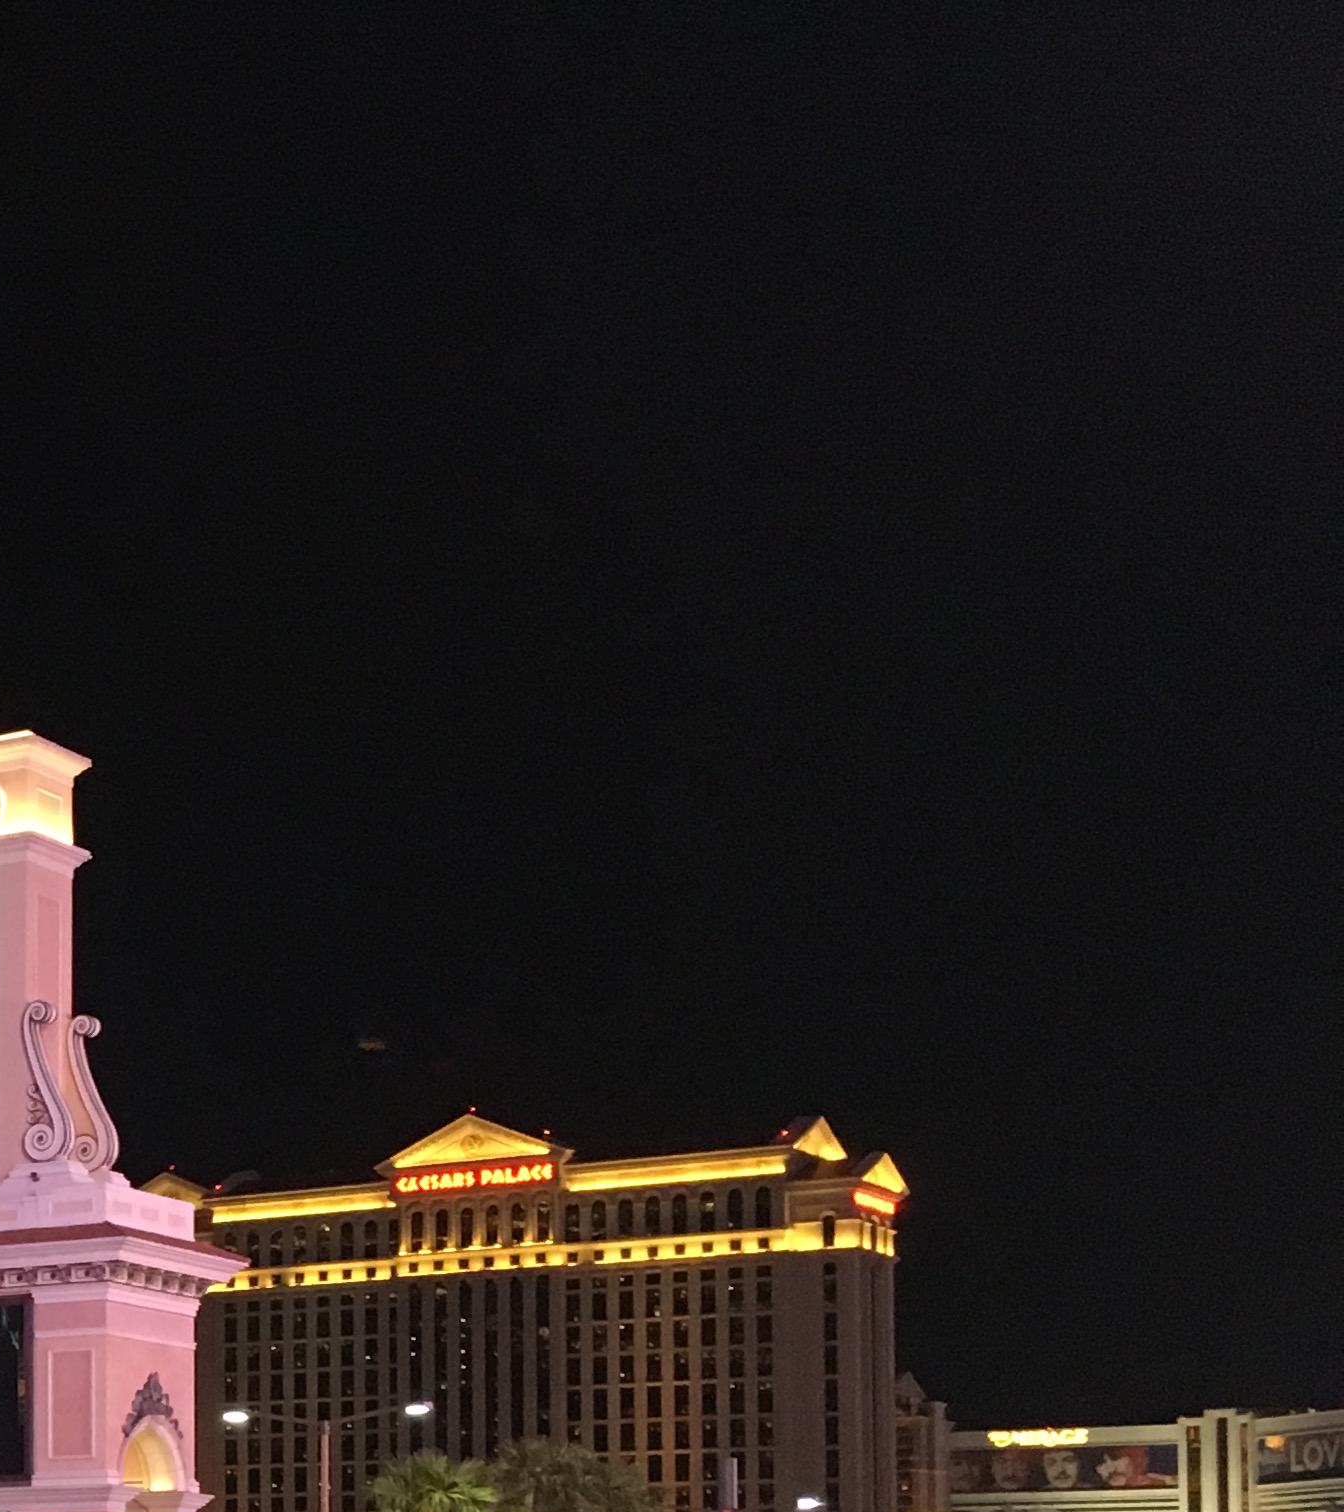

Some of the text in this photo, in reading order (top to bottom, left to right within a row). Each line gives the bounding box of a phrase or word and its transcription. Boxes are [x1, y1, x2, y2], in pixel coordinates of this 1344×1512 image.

[395, 1163, 554, 1193] CAESARS PALACE
[1011, 1428, 1089, 1447] MIRAGE
